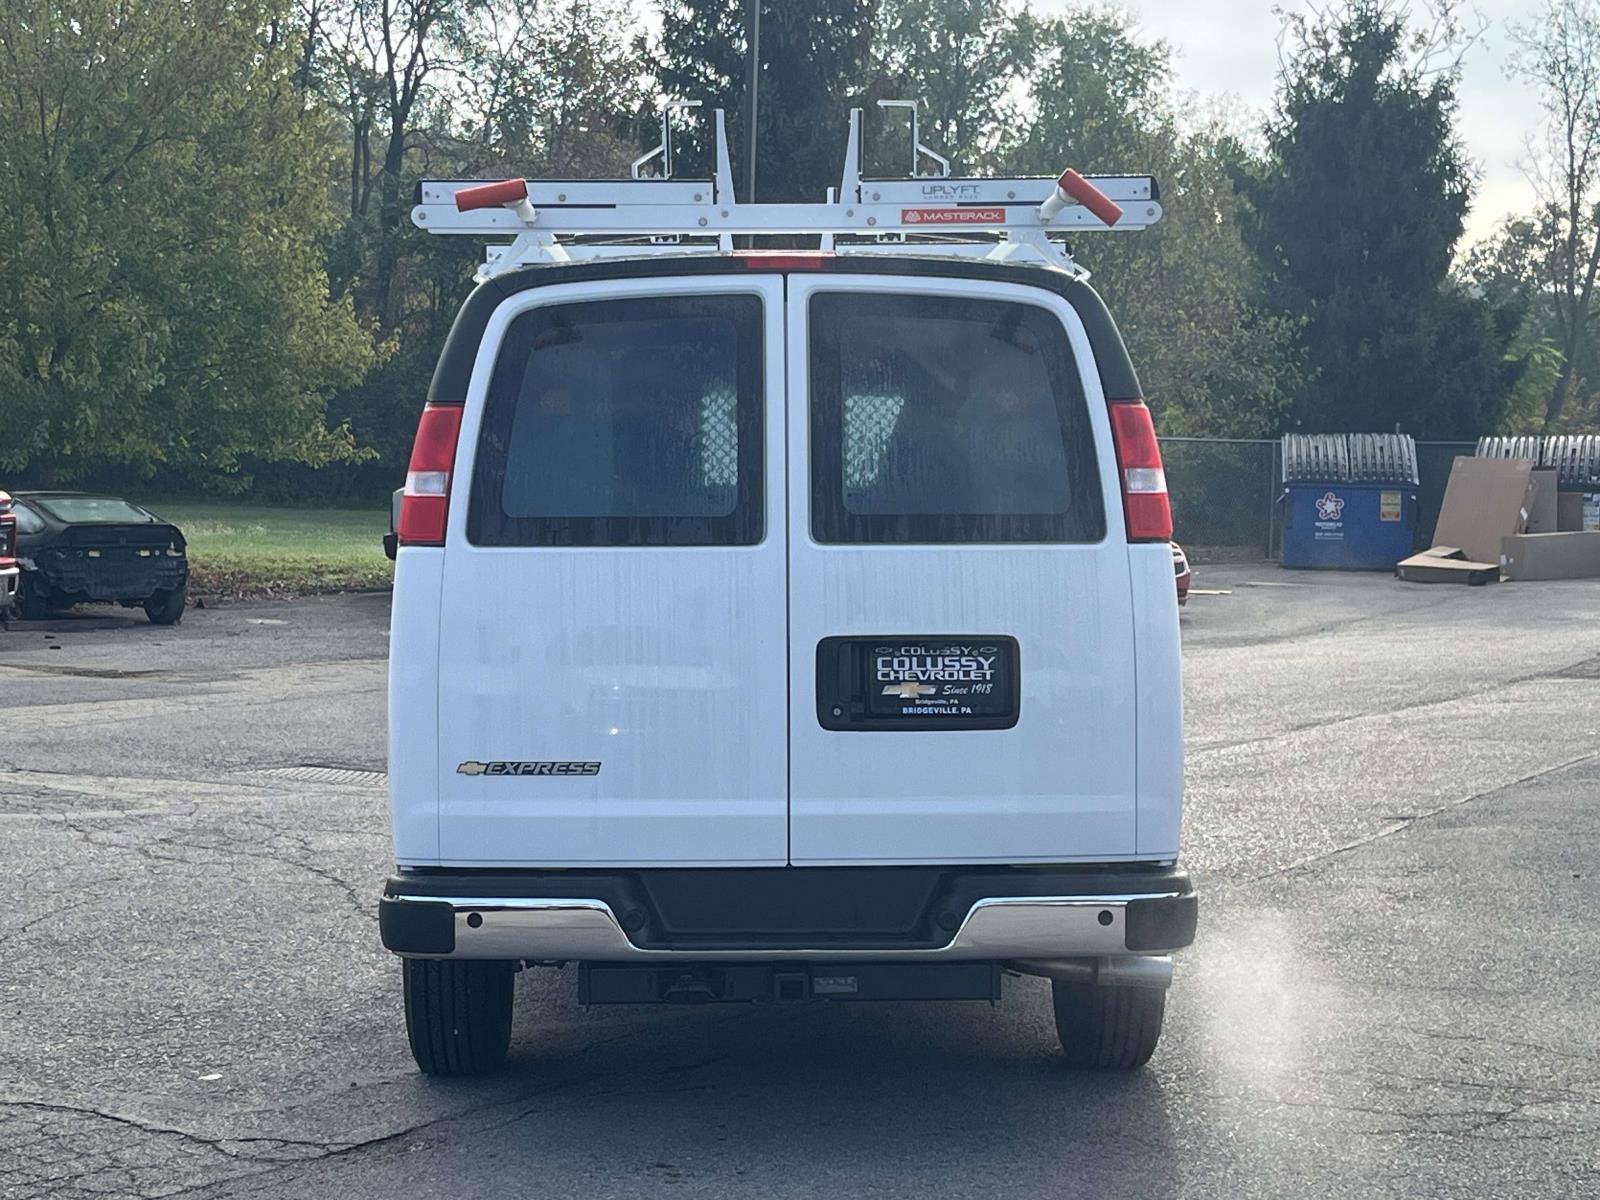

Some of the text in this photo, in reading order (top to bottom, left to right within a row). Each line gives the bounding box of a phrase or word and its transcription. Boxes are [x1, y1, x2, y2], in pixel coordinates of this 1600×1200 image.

[922, 185, 979, 194] UPLYFT
[923, 211, 1001, 221] MASTERACK
[877, 657, 995, 671] COLUSSY
[877, 670, 995, 680] CHEVROLET
[942, 684, 993, 695] Since 1918
[485, 762, 601, 775] EXPRESS
